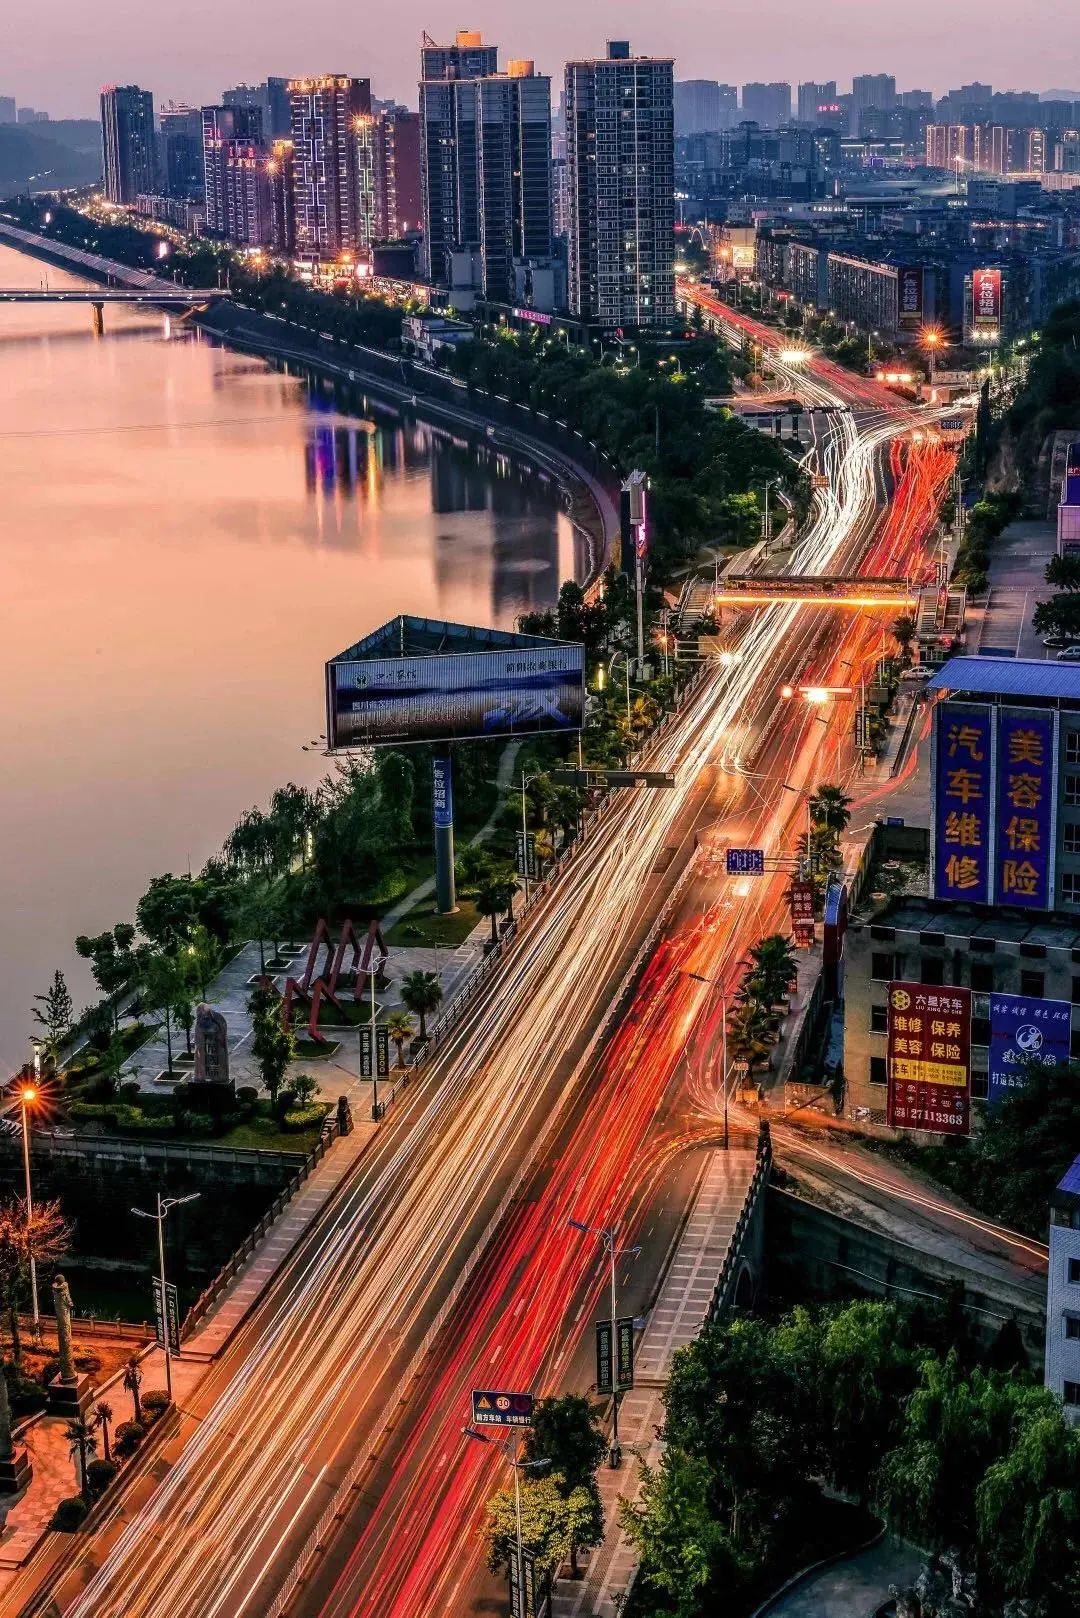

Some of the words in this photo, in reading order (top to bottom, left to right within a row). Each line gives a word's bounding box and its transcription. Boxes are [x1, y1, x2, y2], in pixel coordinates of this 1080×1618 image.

[902, 270, 919, 311] 广告位招商
[979, 274, 995, 316] 广告位招商
[433, 759, 446, 809] 广告位招商
[945, 724, 984, 890] 汽车维修
[1003, 728, 1044, 895] 美容保险
[915, 994, 963, 1010] 六星汽车
[894, 1015, 923, 1033] 维修
[930, 1020, 961, 1038] 保养
[894, 1037, 923, 1055] 美容
[930, 1042, 961, 1060] 保险
[910, 1108, 963, 1125] 27113368
[498, 1399, 509, 1407] 30
[476, 1413, 502, 1423] 前方车站
[506, 1415, 531, 1424] 车辆慢行
